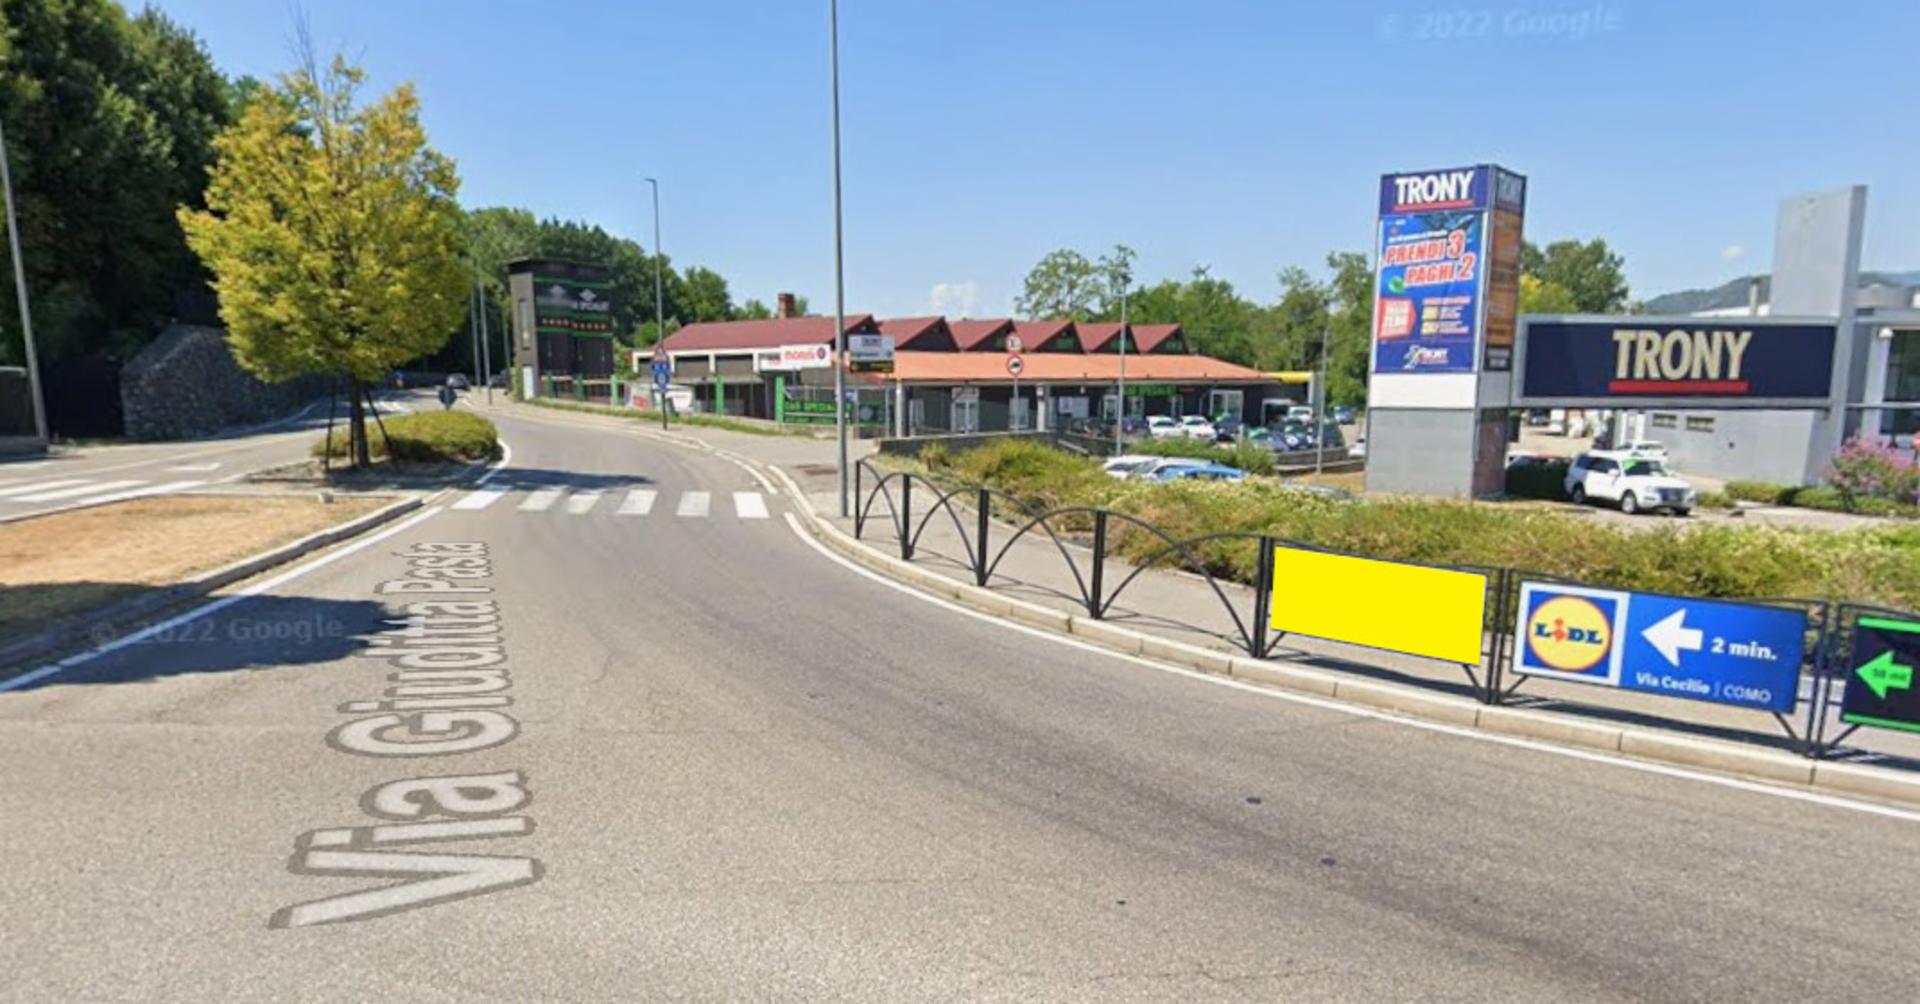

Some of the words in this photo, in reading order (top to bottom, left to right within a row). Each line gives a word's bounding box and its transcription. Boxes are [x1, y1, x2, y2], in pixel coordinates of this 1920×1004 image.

[1394, 170, 1475, 205] TRONY
[1386, 239, 1447, 264] PRENDI
[1446, 229, 1466, 258] 3
[1458, 252, 1476, 280] 2
[1612, 329, 1754, 381] TRONY
[1534, 617, 1604, 645] LIDL
[1711, 636, 1726, 654] 2
[1728, 640, 1778, 661] min.
[1636, 671, 1660, 687] Via
[1661, 675, 1711, 695] Cecilio
[1723, 684, 1772, 703] COMO
